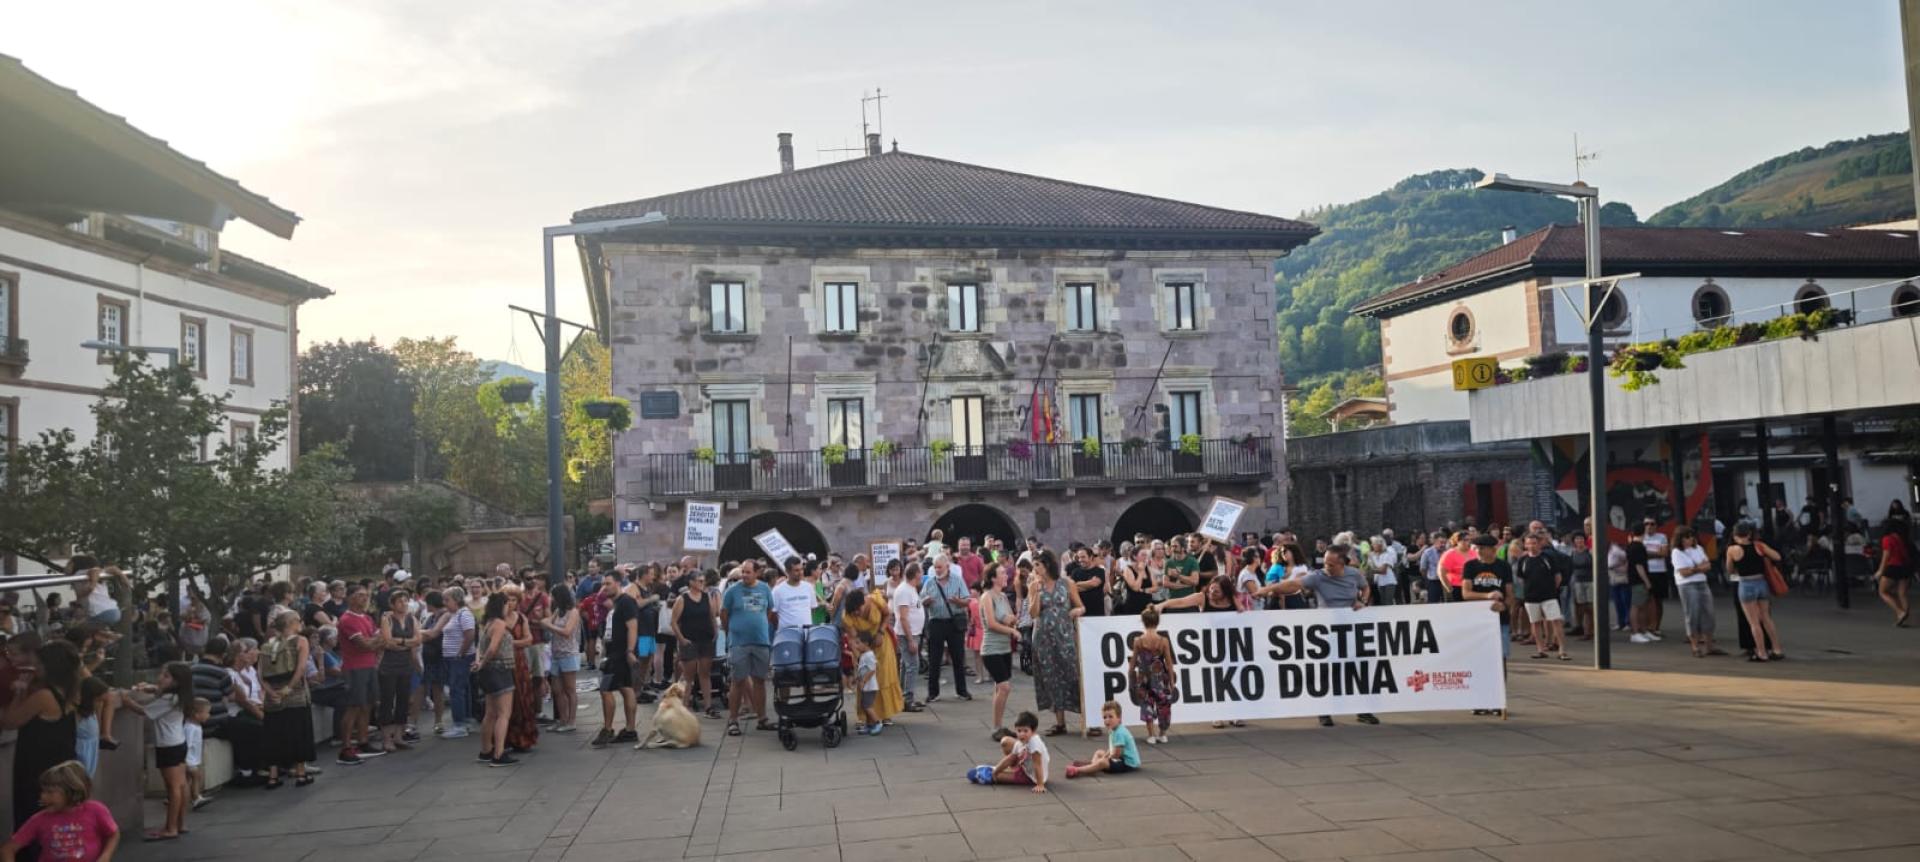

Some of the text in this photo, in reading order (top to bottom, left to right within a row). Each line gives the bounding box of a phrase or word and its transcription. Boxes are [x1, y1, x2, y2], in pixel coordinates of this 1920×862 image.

[1268, 620, 1440, 661] SISTEMA
[1103, 660, 1399, 707] PLIKO DUINA
